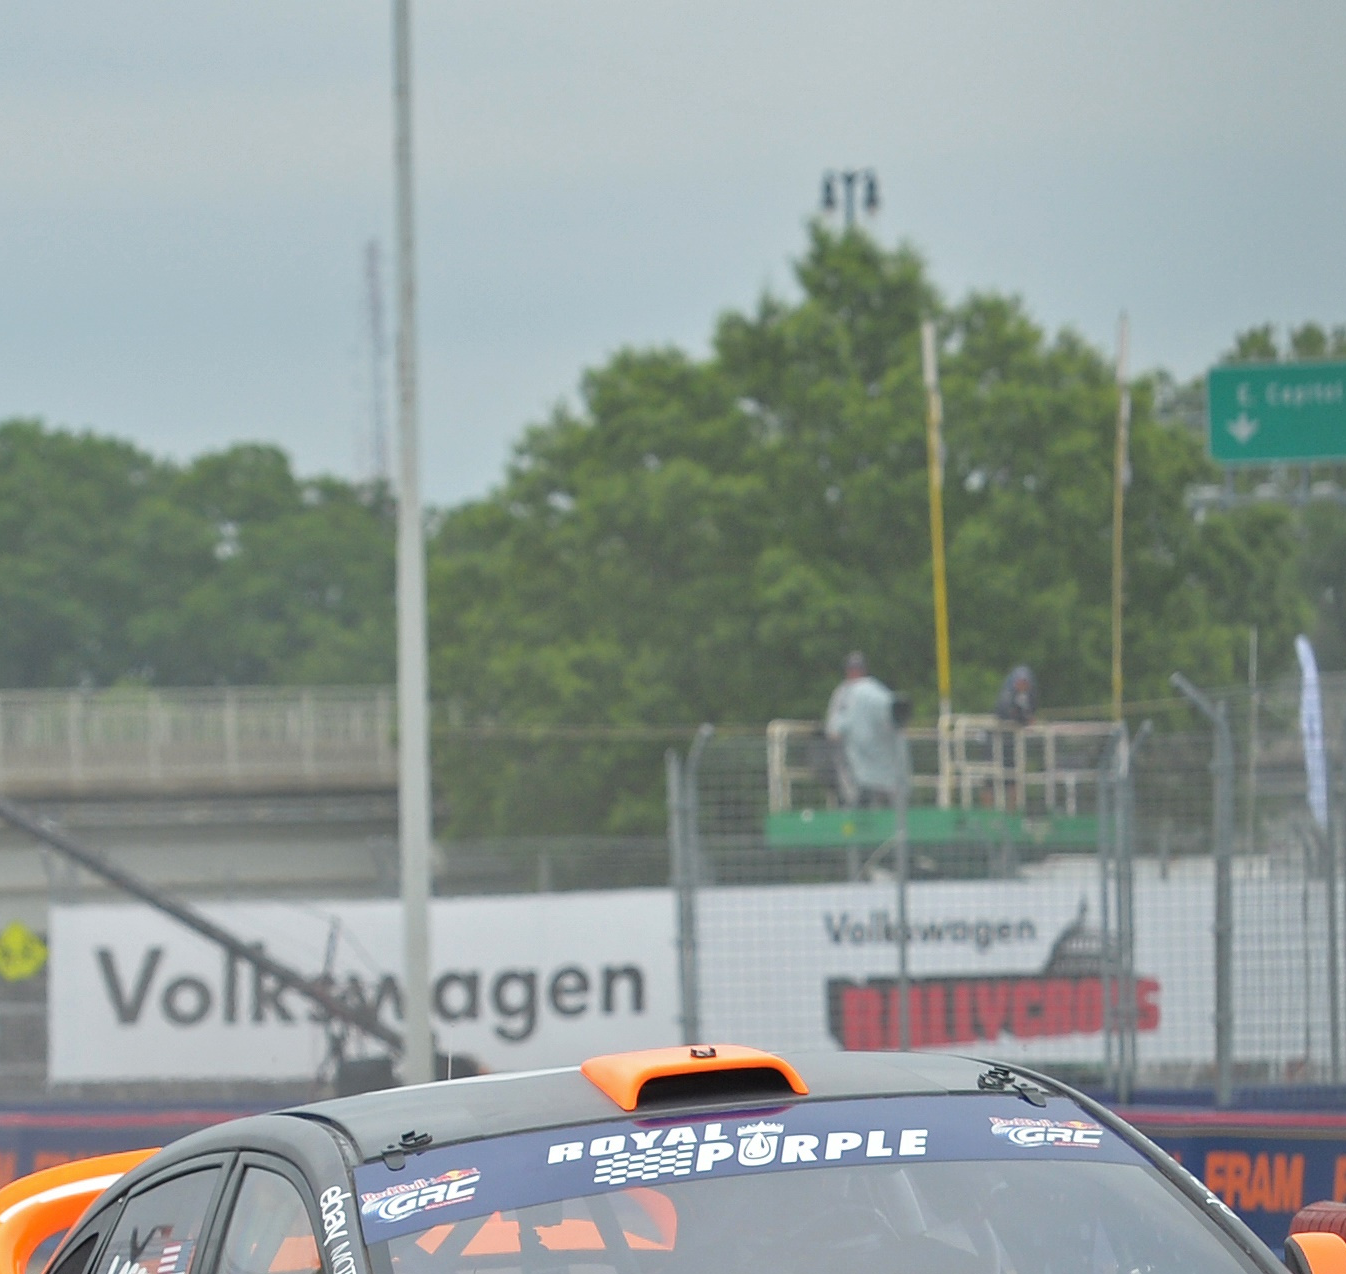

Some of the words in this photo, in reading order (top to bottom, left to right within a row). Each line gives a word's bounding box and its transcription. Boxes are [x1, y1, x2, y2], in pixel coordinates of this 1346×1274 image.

[95, 943, 645, 1043] Volkwagen
[547, 1123, 728, 1165] ROYAL
[696, 1129, 929, 1172] PURPLE
[1204, 1151, 1306, 1212] FRAM
